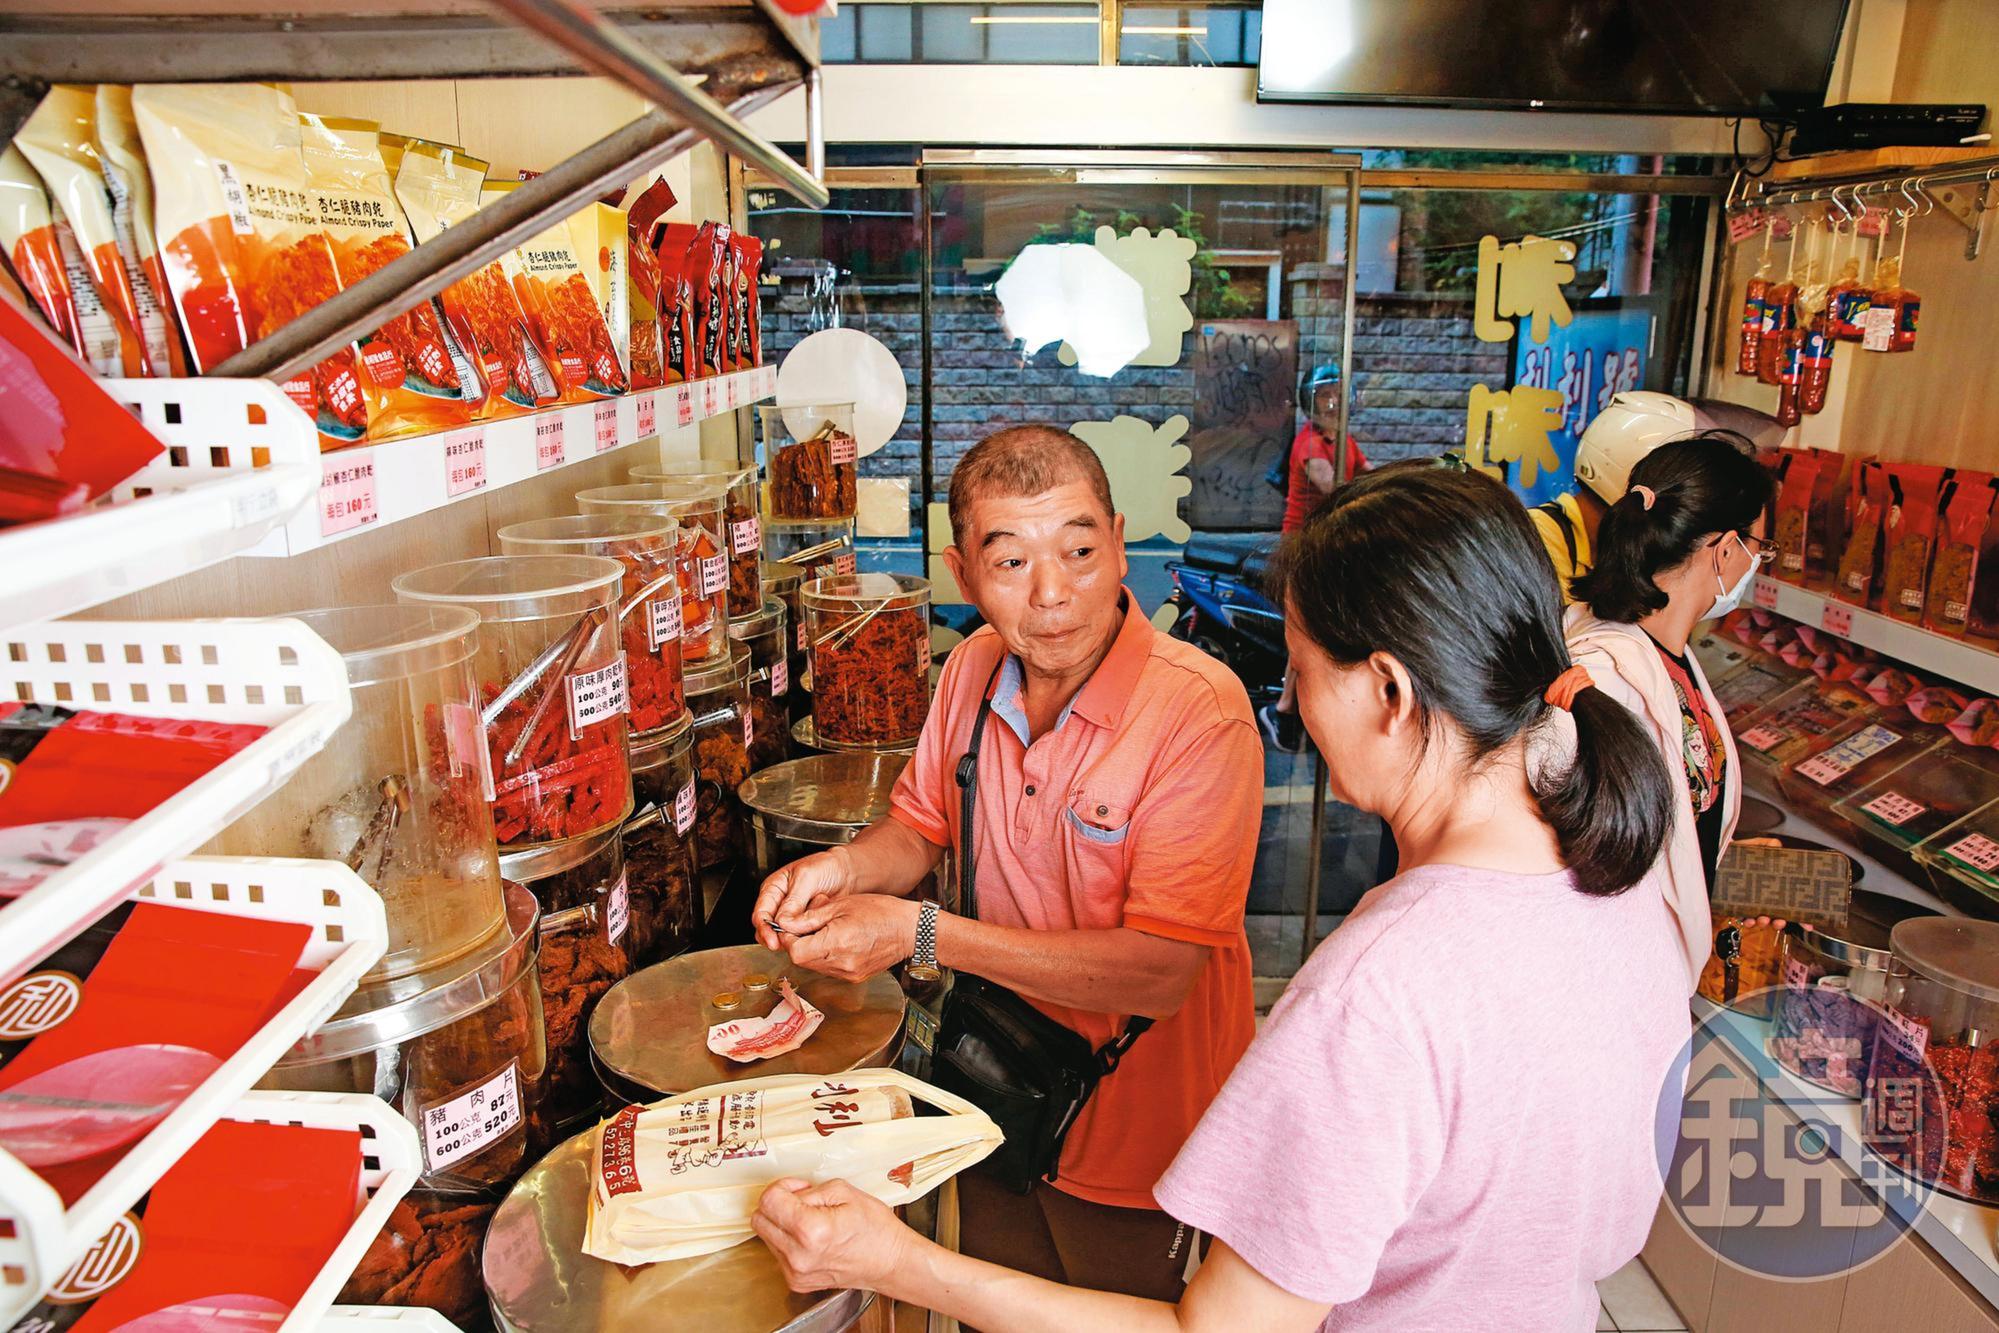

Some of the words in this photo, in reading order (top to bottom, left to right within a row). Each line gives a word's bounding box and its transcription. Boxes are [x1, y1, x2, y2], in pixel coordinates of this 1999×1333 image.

[320, 216, 347, 227] Almond
[348, 217, 371, 228] Crispy
[372, 218, 394, 229] Paper
[577, 686, 608, 704] 100公克
[435, 1111, 482, 1139] 100公克
[490, 1088, 514, 1112] 87元
[437, 1128, 483, 1156] 600公克
[484, 1104, 517, 1133] 520元
